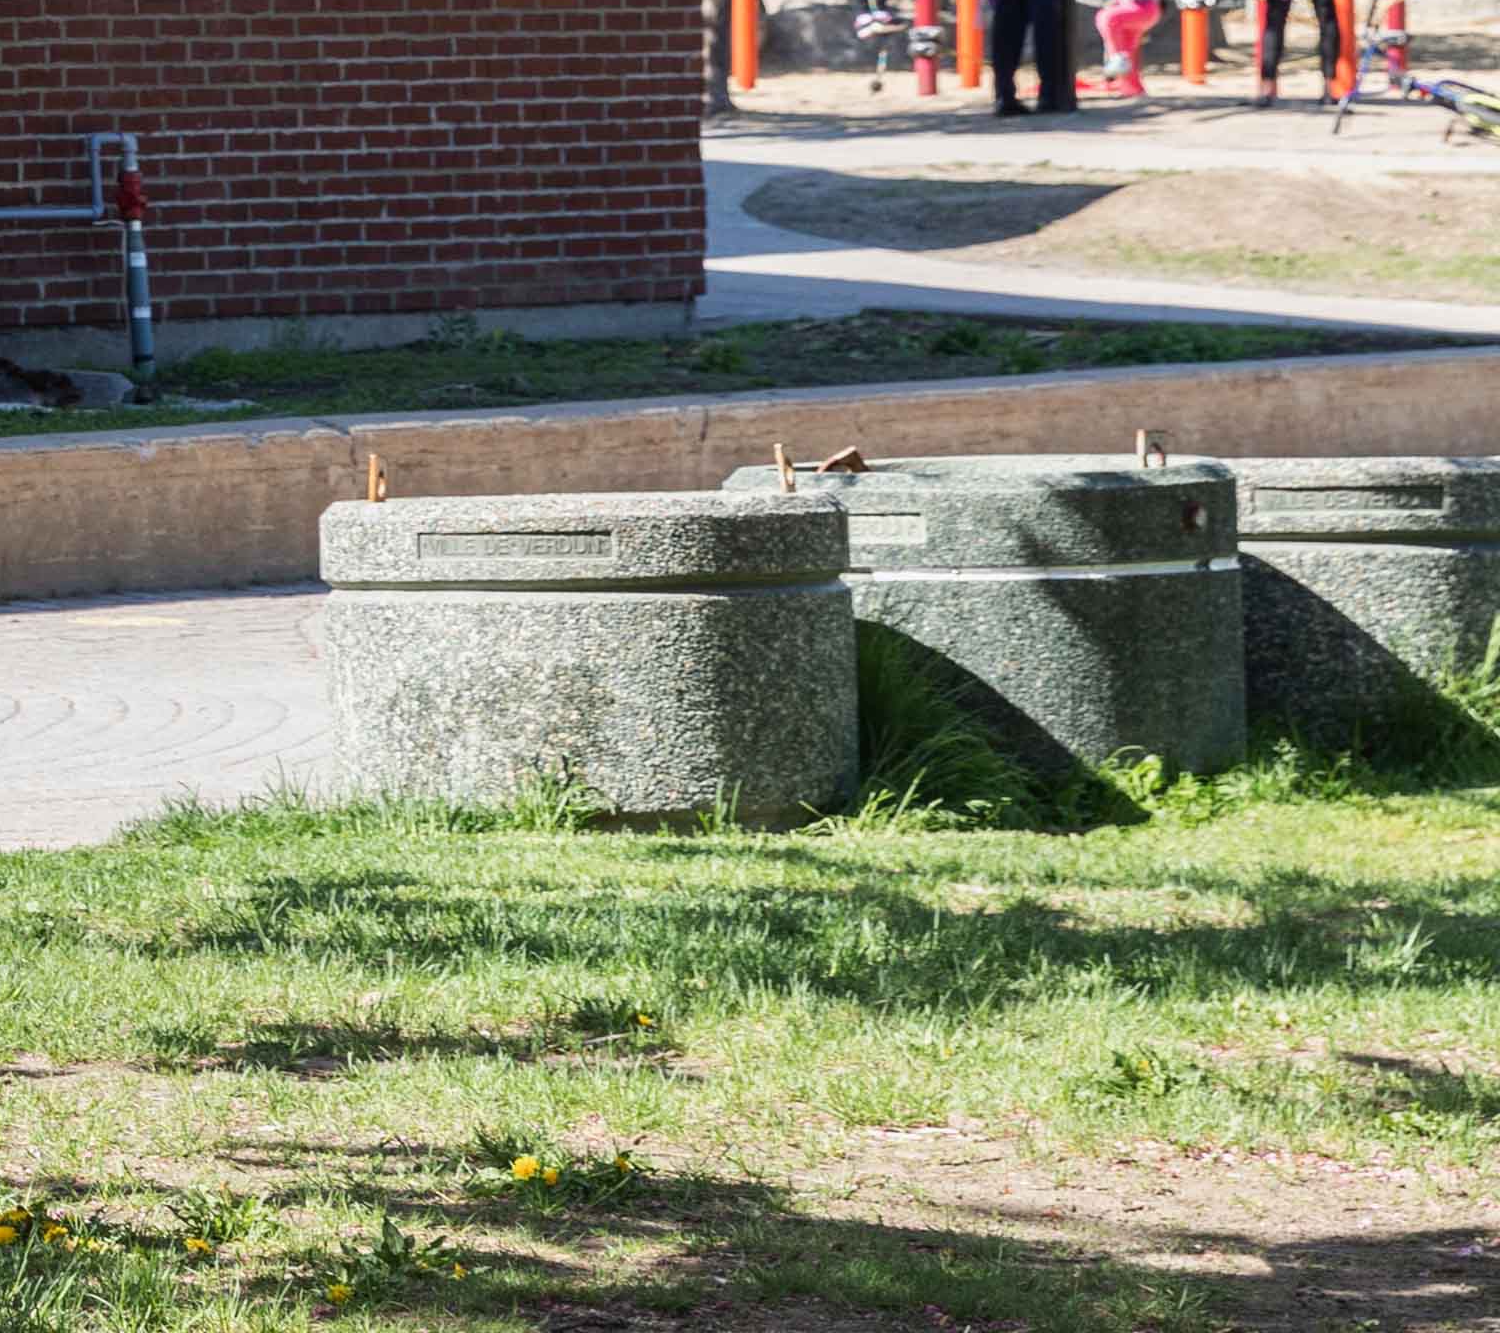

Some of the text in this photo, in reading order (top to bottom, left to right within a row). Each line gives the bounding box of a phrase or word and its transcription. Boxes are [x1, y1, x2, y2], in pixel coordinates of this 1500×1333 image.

[426, 535, 605, 557] VILLE DE VERDUN
